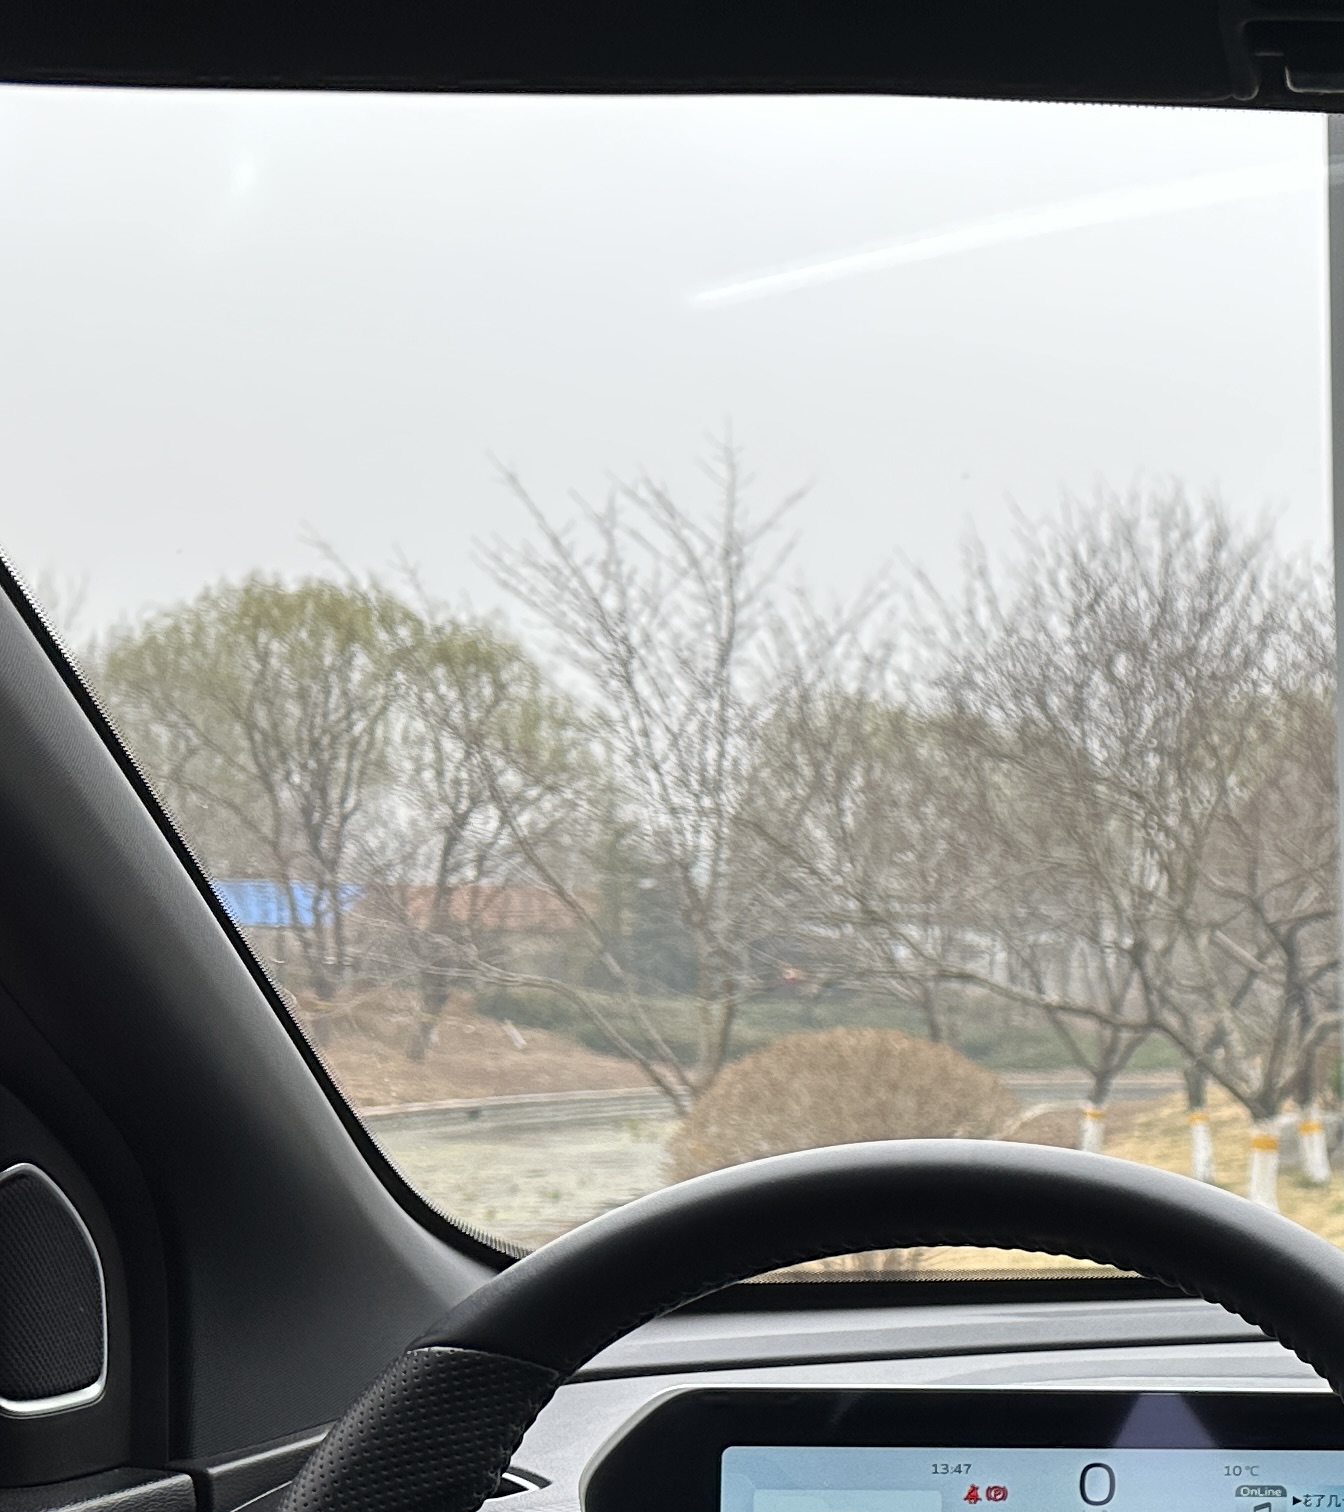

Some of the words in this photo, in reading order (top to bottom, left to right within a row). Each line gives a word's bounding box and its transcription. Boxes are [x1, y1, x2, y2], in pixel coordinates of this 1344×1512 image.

[931, 1463, 972, 1475] 13:47
[1078, 1461, 1117, 1506] 0
[1240, 1486, 1282, 1497] OnLine
